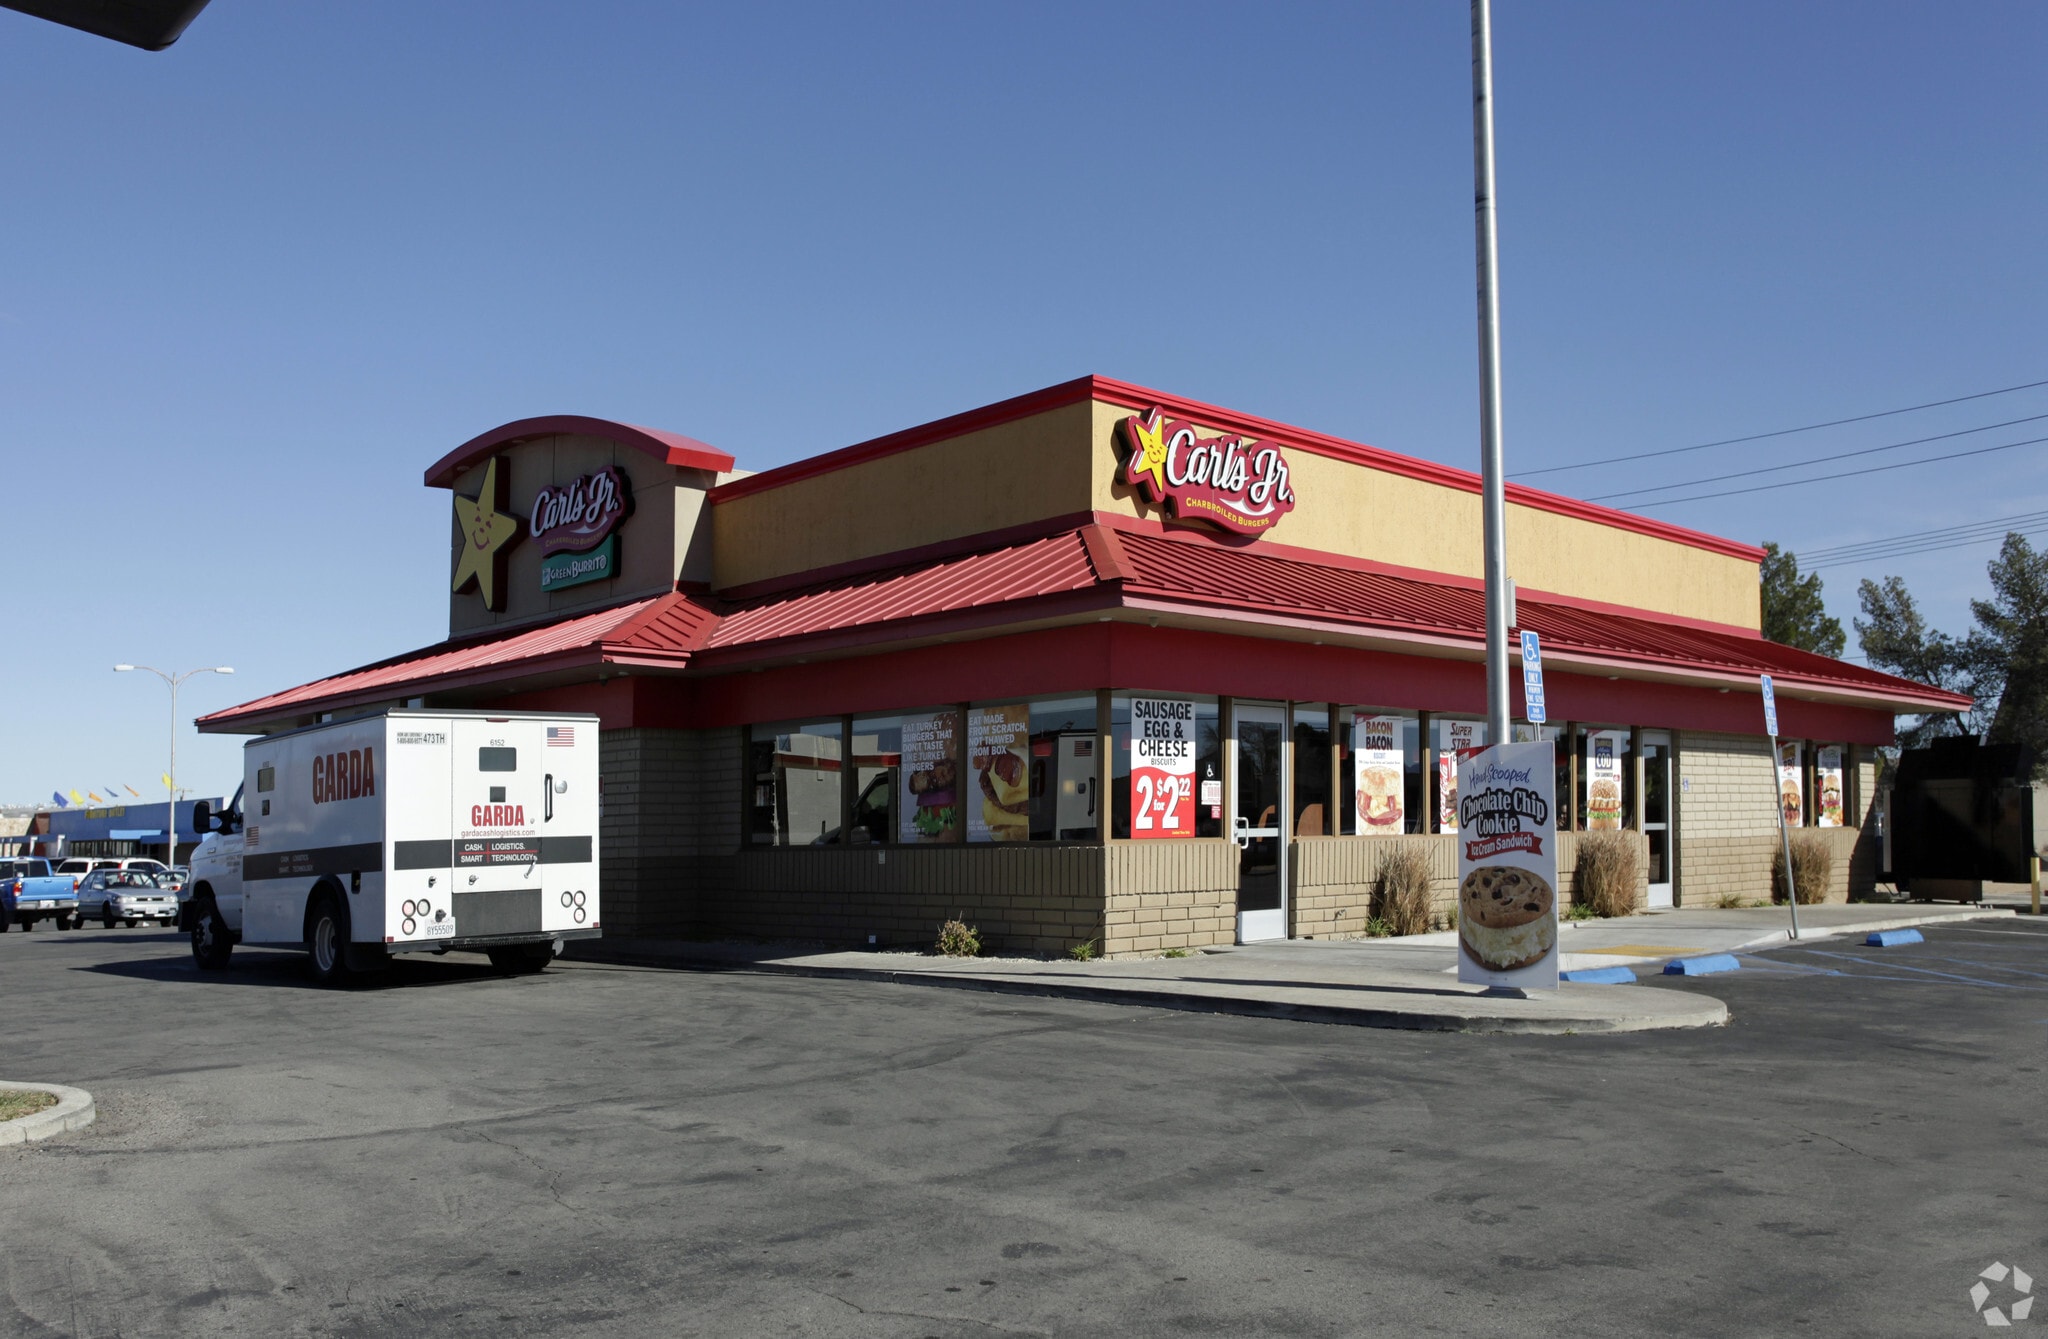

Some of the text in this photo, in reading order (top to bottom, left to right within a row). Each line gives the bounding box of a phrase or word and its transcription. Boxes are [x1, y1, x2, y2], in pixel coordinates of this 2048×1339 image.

[1166, 428, 1294, 504] Carl's Jr.
[530, 471, 618, 538] Carl's Jr.
[1186, 497, 1270, 527] CHARBROILED BURGERS
[1135, 700, 1192, 720] SAUSAGE
[968, 714, 1004, 726] EAT MADE
[902, 721, 943, 733] EAT TURKEY
[968, 722, 1028, 735] FROM SCRATCH,
[1144, 720, 1183, 739] EGG &
[1366, 721, 1393, 736] BACON
[1450, 722, 1472, 736] SUPER
[423, 733, 445, 743] 473TH
[490, 739, 505, 747] 6152
[902, 730, 953, 743] BURGERS THAT
[968, 734, 1015, 746] NOT THAWED
[1366, 735, 1393, 750] BACON
[923, 741, 943, 750] TASTE
[968, 745, 1008, 756] FROM BOX
[1139, 739, 1188, 757] CHEESE
[919, 751, 945, 760] TURKEY
[1150, 758, 1177, 766] BISCUITS
[1596, 753, 1612, 768] COD
[902, 762, 934, 772] BURGERS
[312, 746, 375, 805] GARDA
[1135, 775, 1153, 830] 2
[1153, 799, 1165, 811] for
[1462, 789, 1545, 826] Chocolate Chip
[471, 805, 525, 827] GARDA
[1478, 812, 1518, 835] Cookie
[461, 829, 535, 838] gardacashlogistics.com
[464, 842, 526, 851] CASH. LOGISTICS.
[1471, 834, 1533, 856] Ice Cream Sandwich
[461, 855, 483, 863] SMART
[426, 924, 454, 936] 8Y55509
